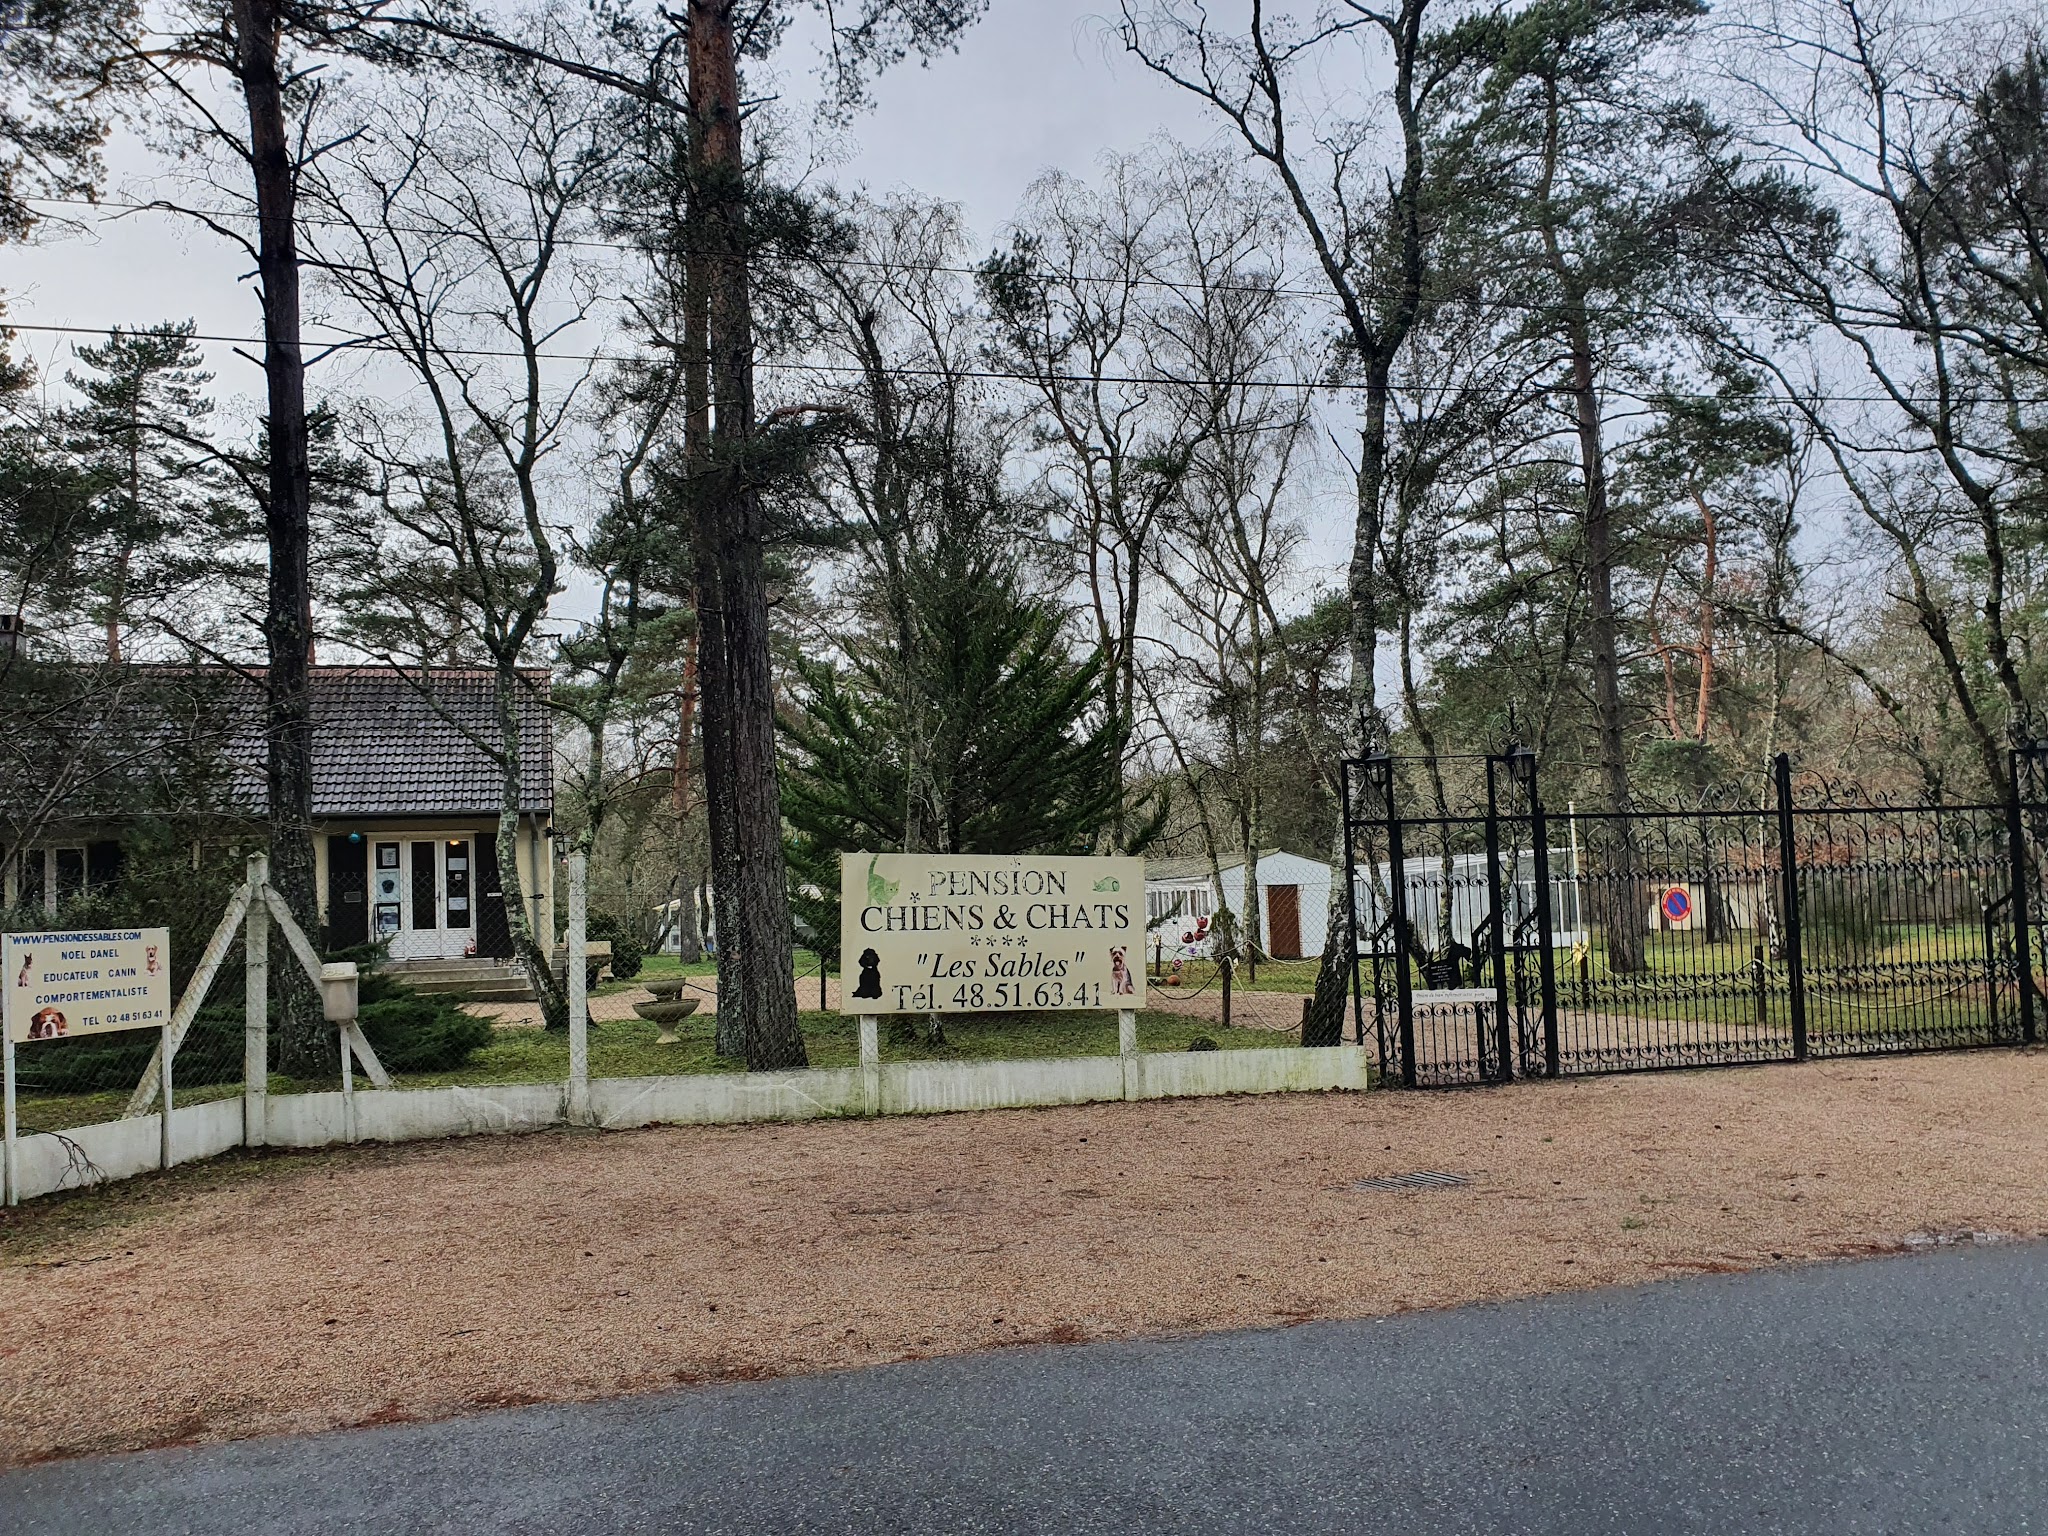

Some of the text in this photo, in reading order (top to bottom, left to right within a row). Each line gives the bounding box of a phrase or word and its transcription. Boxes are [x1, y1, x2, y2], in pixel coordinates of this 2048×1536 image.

[928, 870, 1067, 896] PENSION
[860, 903, 1129, 932] CHIENS & CHATS
[12, 932, 142, 945] WWW.PENSIONDESSABLES.COM
[61, 949, 120, 960] NOEL DANEL
[43, 968, 137, 983] EDUCATEUR CANIN
[35, 986, 149, 1005] COMPORTEMENTALISTE
[891, 981, 1102, 1010] Tél. 48.51.63.41
[82, 1009, 163, 1026] TEL 02 48 51 63 41
